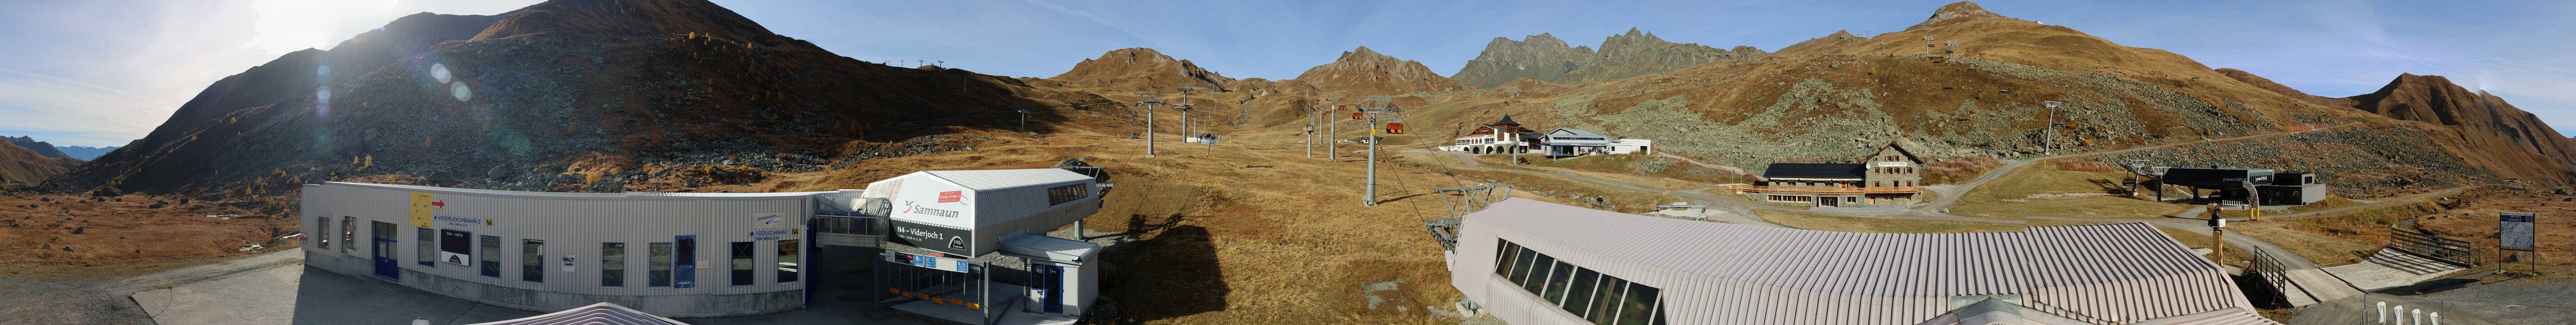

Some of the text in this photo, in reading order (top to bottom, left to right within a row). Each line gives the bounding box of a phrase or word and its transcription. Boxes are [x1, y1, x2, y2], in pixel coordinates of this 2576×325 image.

[914, 205, 959, 218] Samnaun
[438, 216, 477, 224] VIDERJOCHBAHN
[910, 228, 938, 239] Viderjoch
